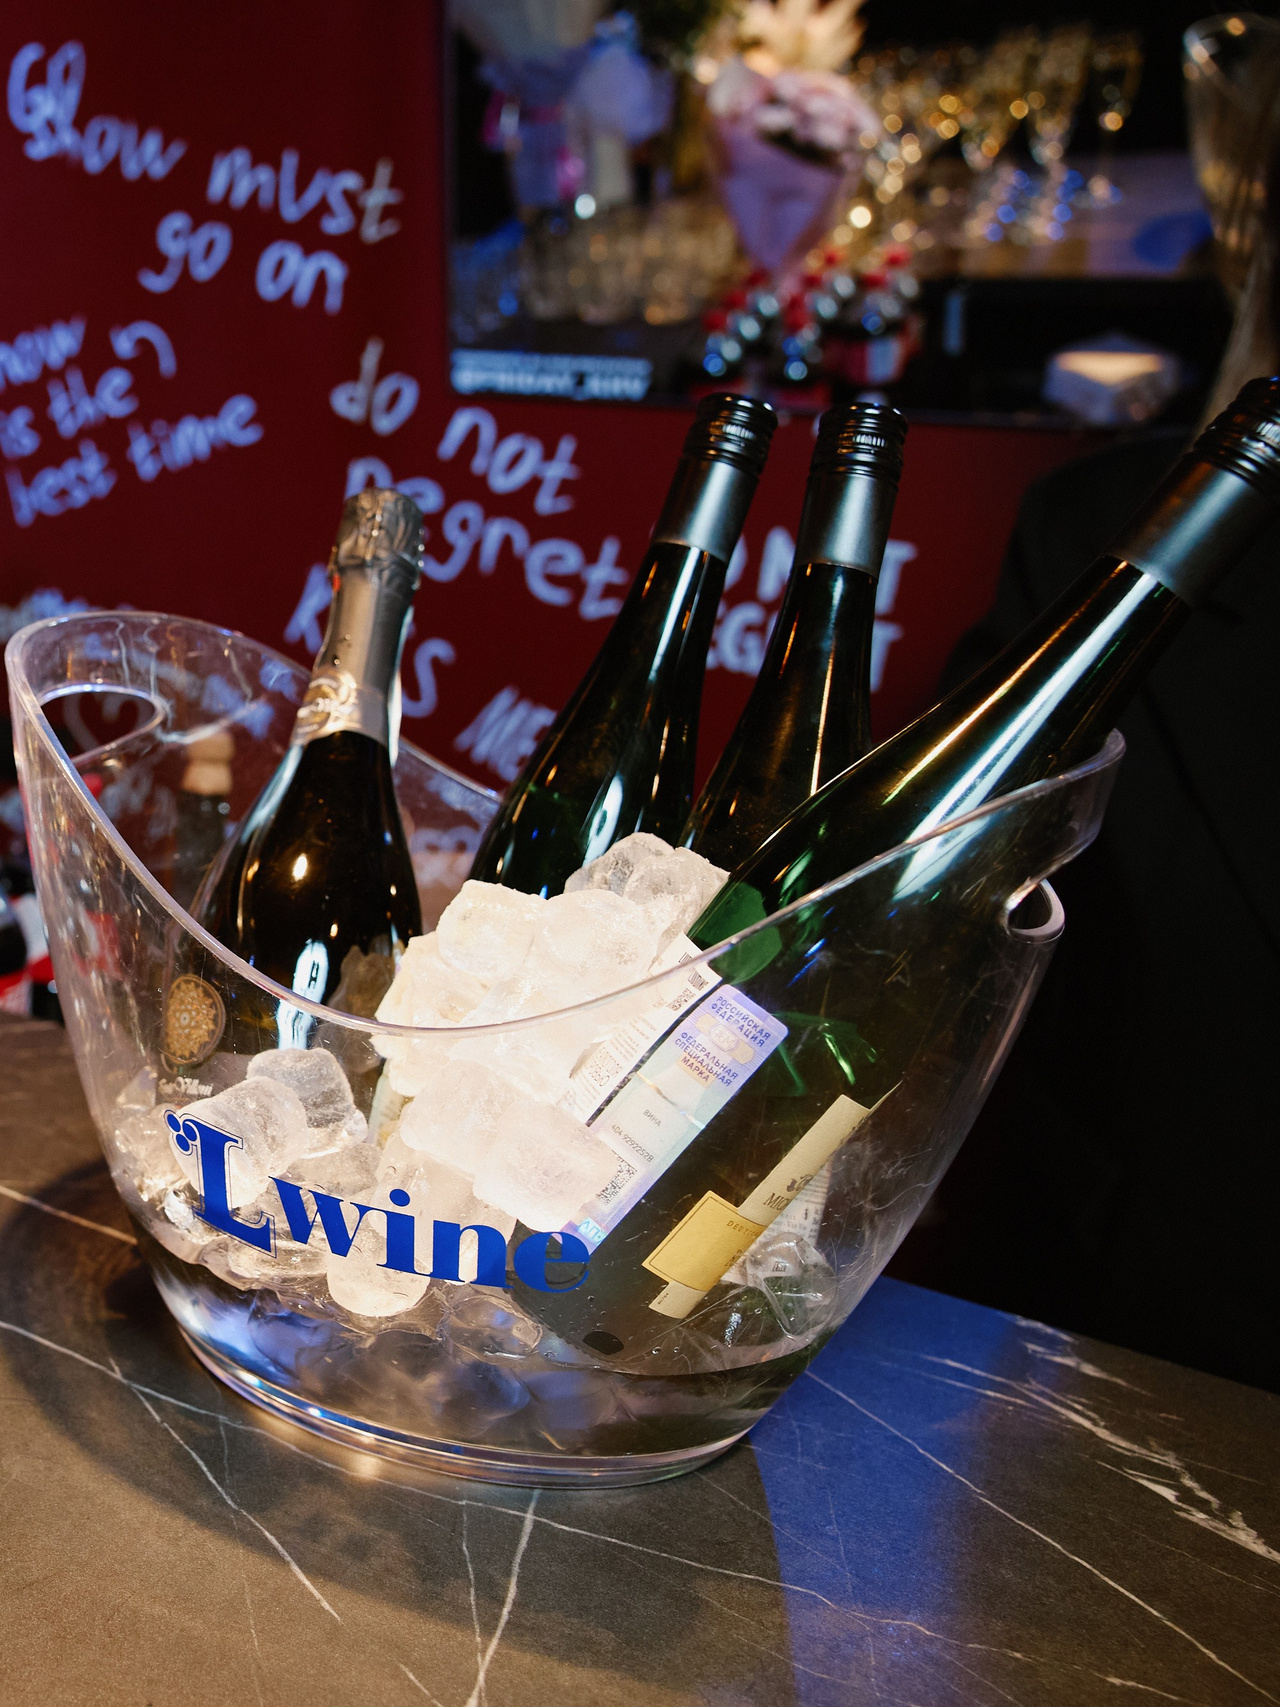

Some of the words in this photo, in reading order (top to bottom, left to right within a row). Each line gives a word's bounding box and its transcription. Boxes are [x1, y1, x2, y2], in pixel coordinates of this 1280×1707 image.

[137, 211, 232, 293] go
[255, 240, 348, 316] on
[329, 336, 420, 436] do
[126, 393, 265, 482] time
[436, 406, 582, 516] not
[711, 1003, 765, 1047] ФЕДЕРАЦИЯ
[716, 996, 771, 1040] РОССИЙСКАЯ
[674, 1038, 733, 1087] СПЕЦИАЛЬНАЯ
[680, 1032, 739, 1080] ФЕДЕРАЛЬНАЯ
[681, 1056, 710, 1082] МАРКА
[643, 1109, 662, 1127] ВИНА
